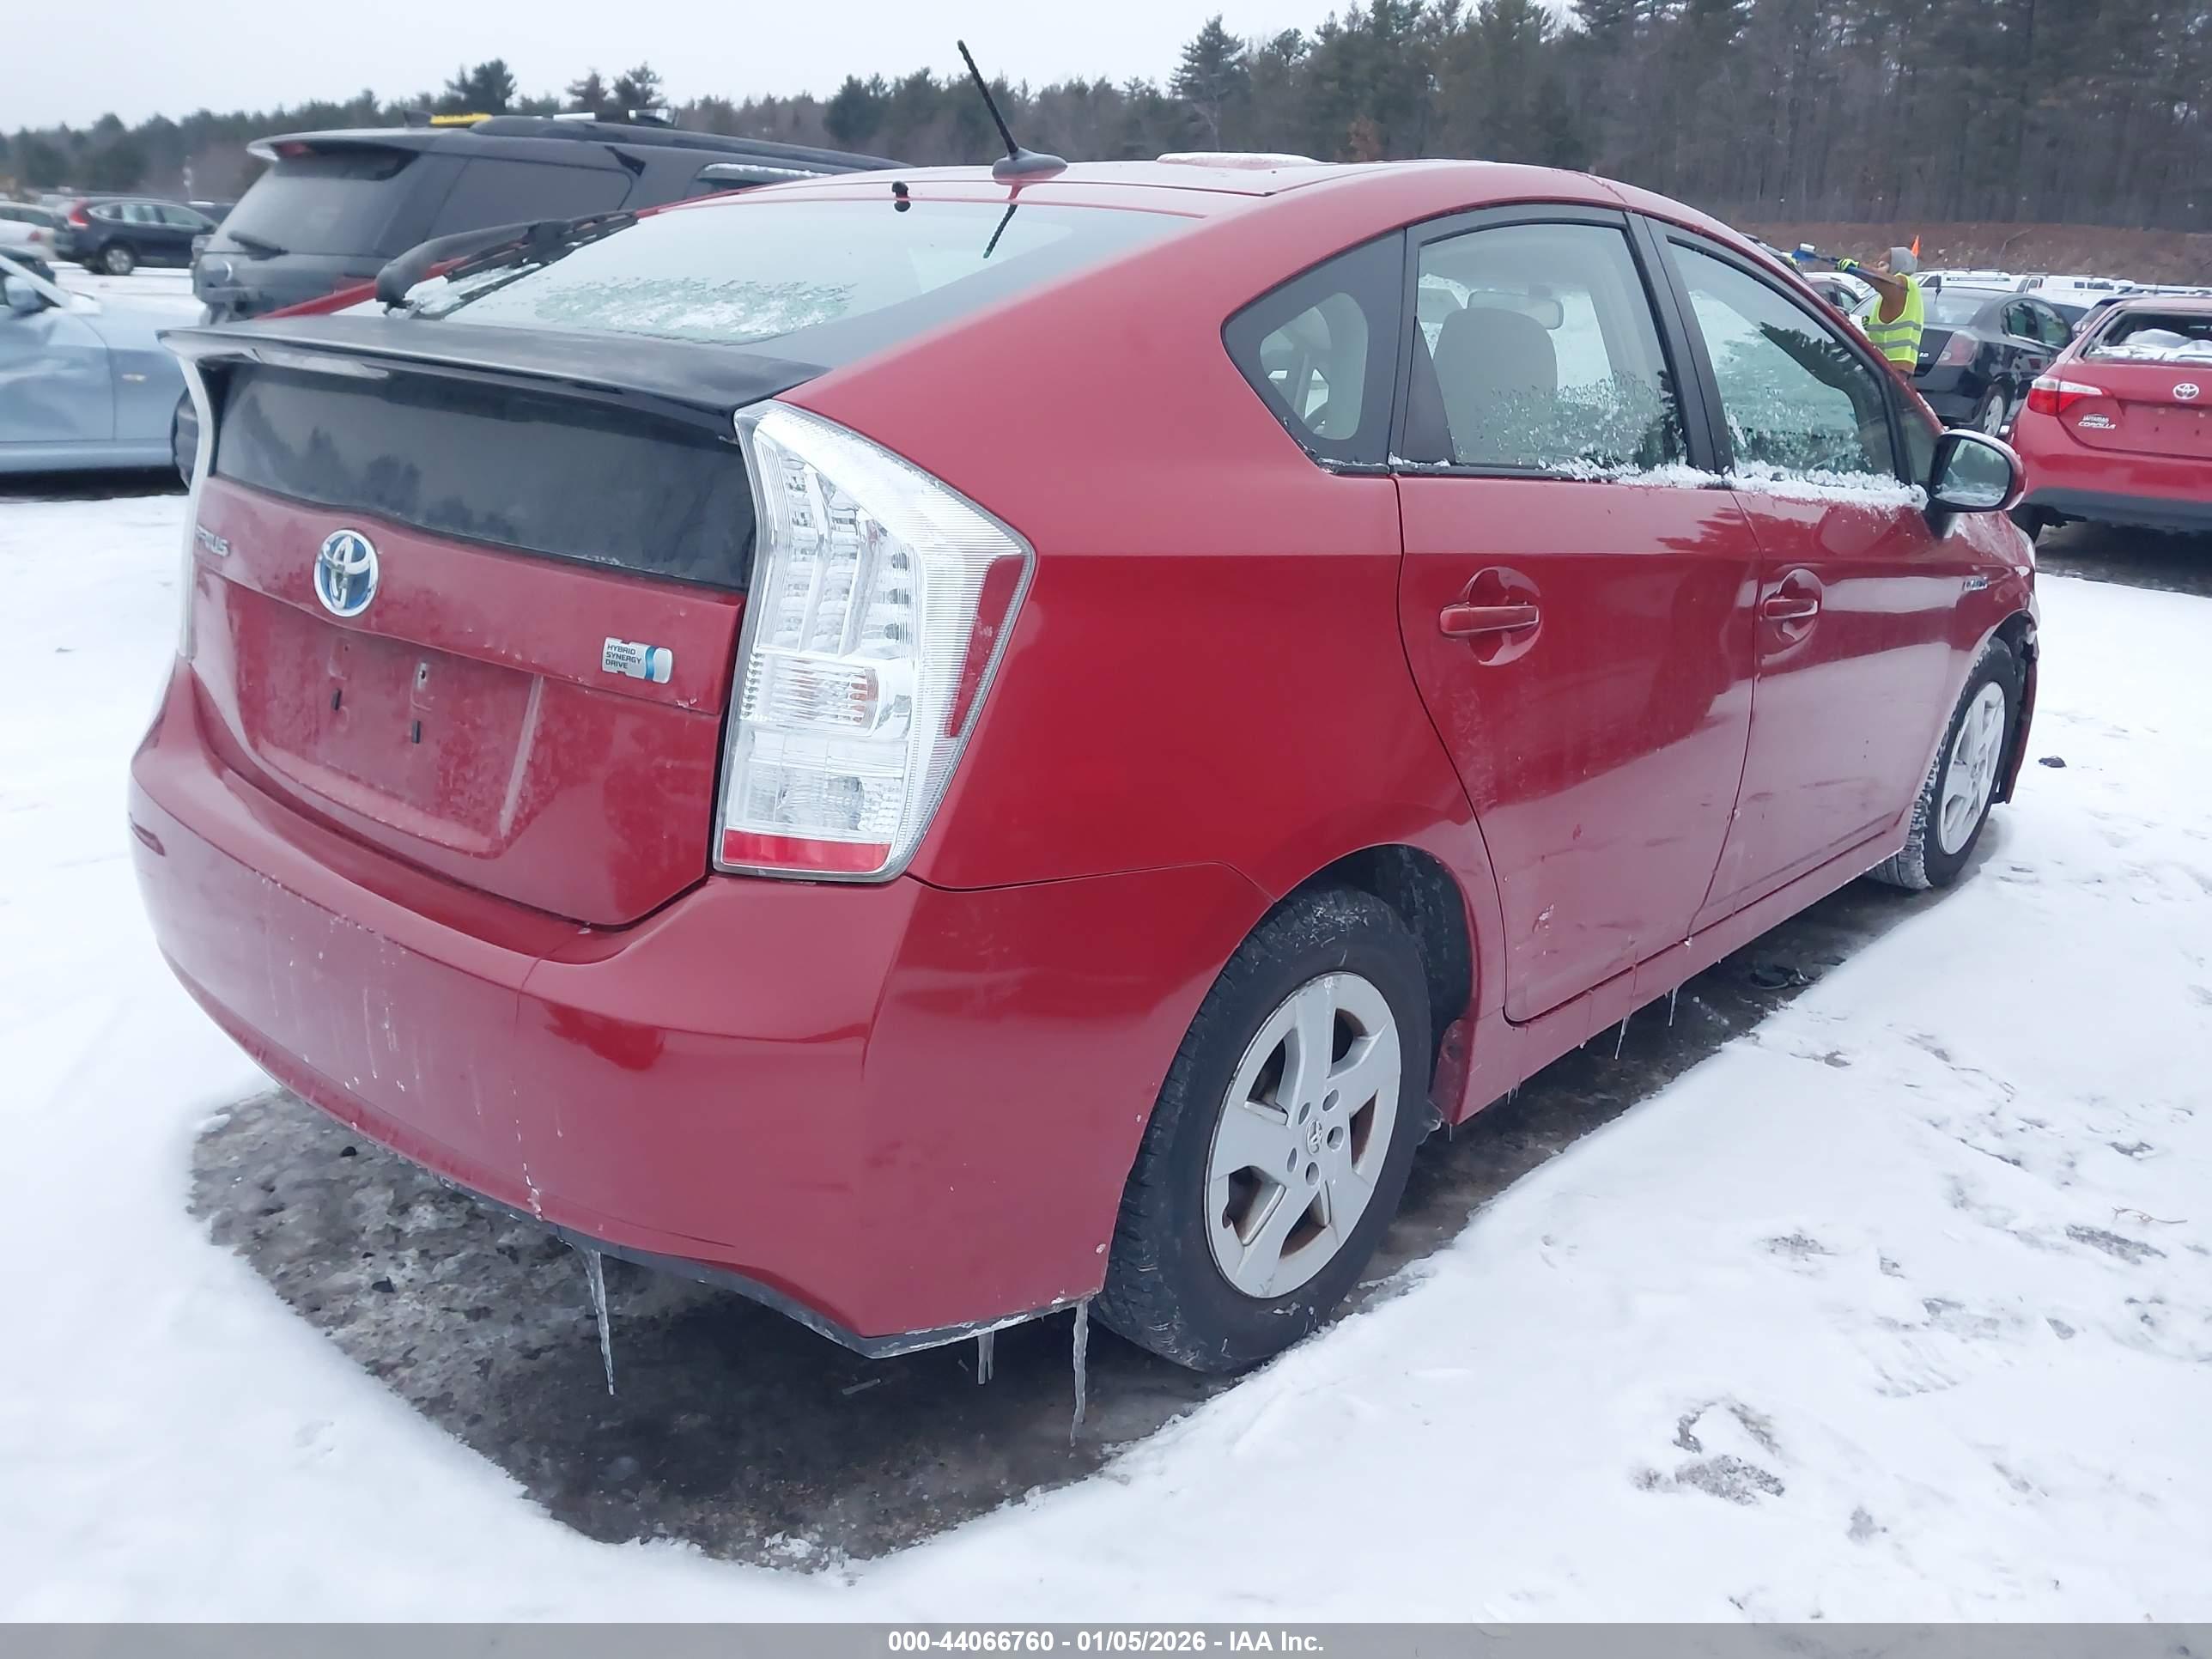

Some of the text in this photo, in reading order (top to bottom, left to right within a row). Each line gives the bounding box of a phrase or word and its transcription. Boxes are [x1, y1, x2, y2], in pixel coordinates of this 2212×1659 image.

[2078, 421, 2117, 429] COROLLA
[607, 644, 636, 655] HYBRID
[605, 652, 642, 665] SYNERGY
[605, 659, 629, 669] DRIVE
